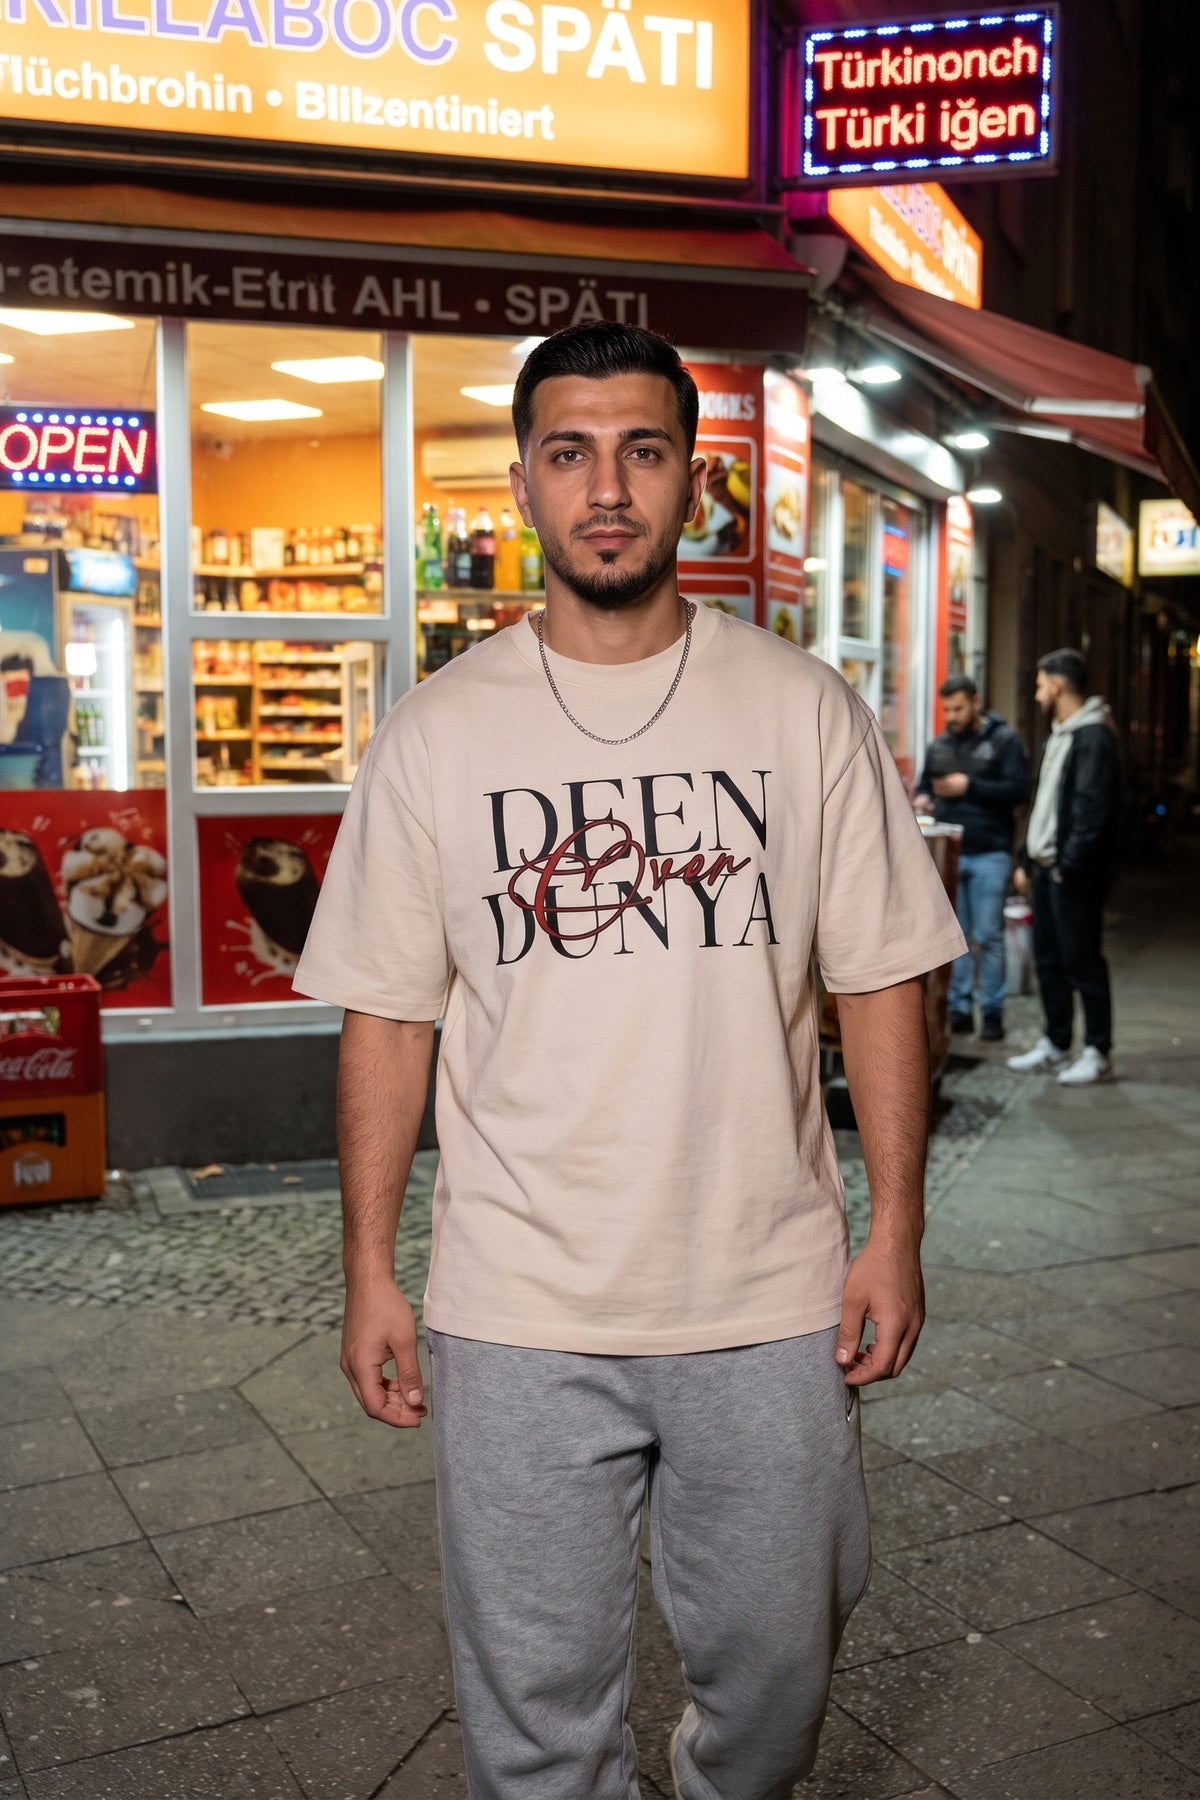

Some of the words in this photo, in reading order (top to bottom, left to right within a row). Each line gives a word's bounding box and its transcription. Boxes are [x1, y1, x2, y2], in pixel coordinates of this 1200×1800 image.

[483, 0, 713, 90] SPÄTI
[814, 37, 1038, 91] Türkinonch
[816, 103, 926, 151] Türki
[940, 97, 1035, 151] iğen
[352, 275, 460, 321] AHL
[504, 278, 648, 329] SPÄTI
[0, 424, 148, 474] OPEN
[483, 770, 772, 874] DEEN
[508, 819, 751, 941] Over
[482, 872, 780, 966] DUNYA
